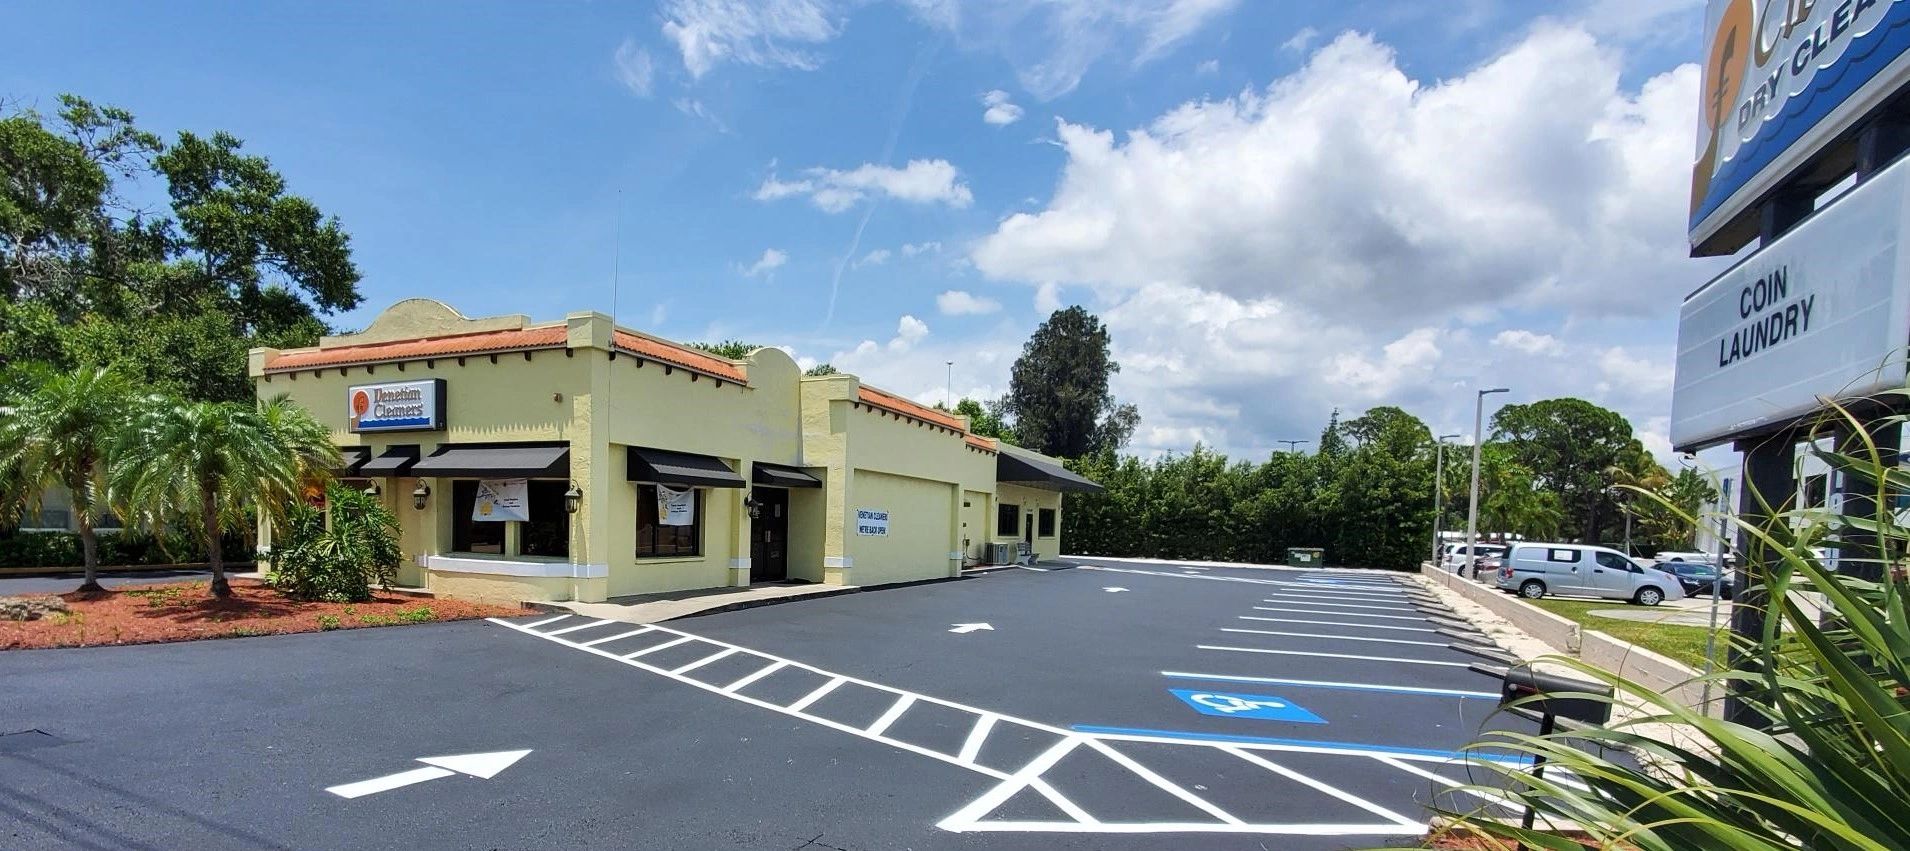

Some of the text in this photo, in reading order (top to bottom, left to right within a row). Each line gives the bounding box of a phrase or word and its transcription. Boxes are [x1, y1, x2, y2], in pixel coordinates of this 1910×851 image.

[1738, 60, 1785, 132] DRY
[1740, 265, 1787, 319] COIN
[1719, 294, 1815, 368] LAUNDRY
[374, 387, 421, 403] Venetian
[374, 403, 423, 418] Cleaners
